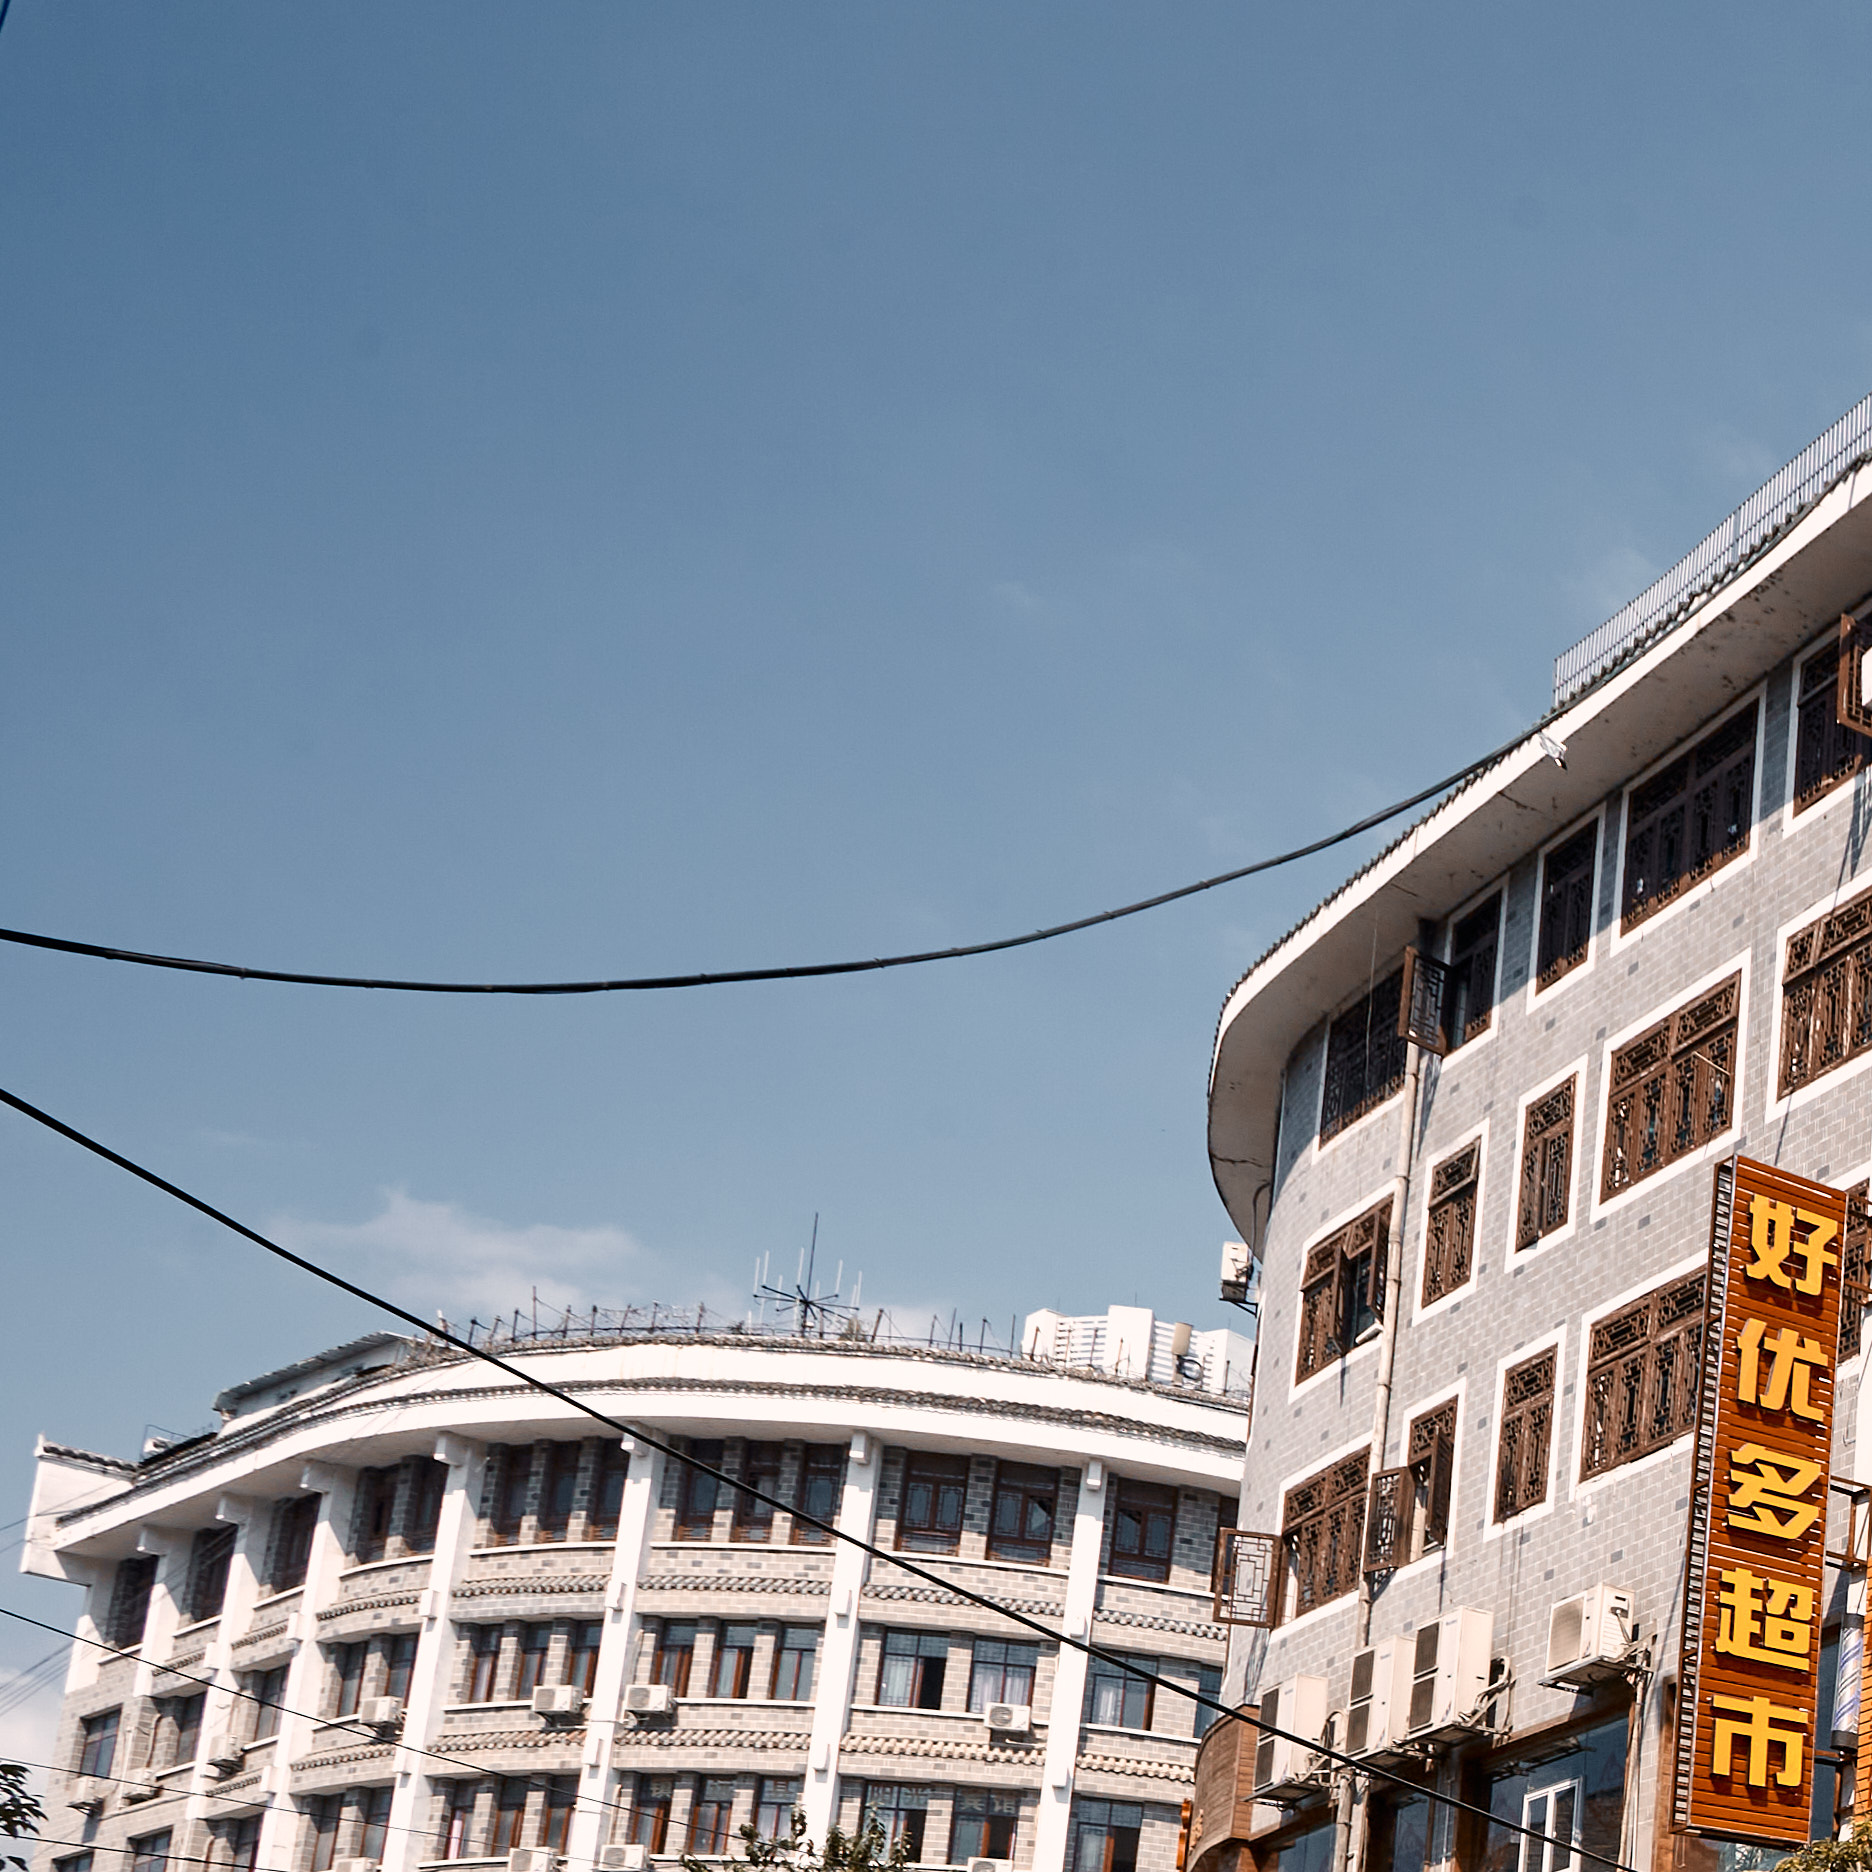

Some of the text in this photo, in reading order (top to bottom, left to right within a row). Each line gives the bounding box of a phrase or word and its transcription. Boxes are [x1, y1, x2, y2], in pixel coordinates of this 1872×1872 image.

[1712, 1194, 1839, 1788] 好优多超市
